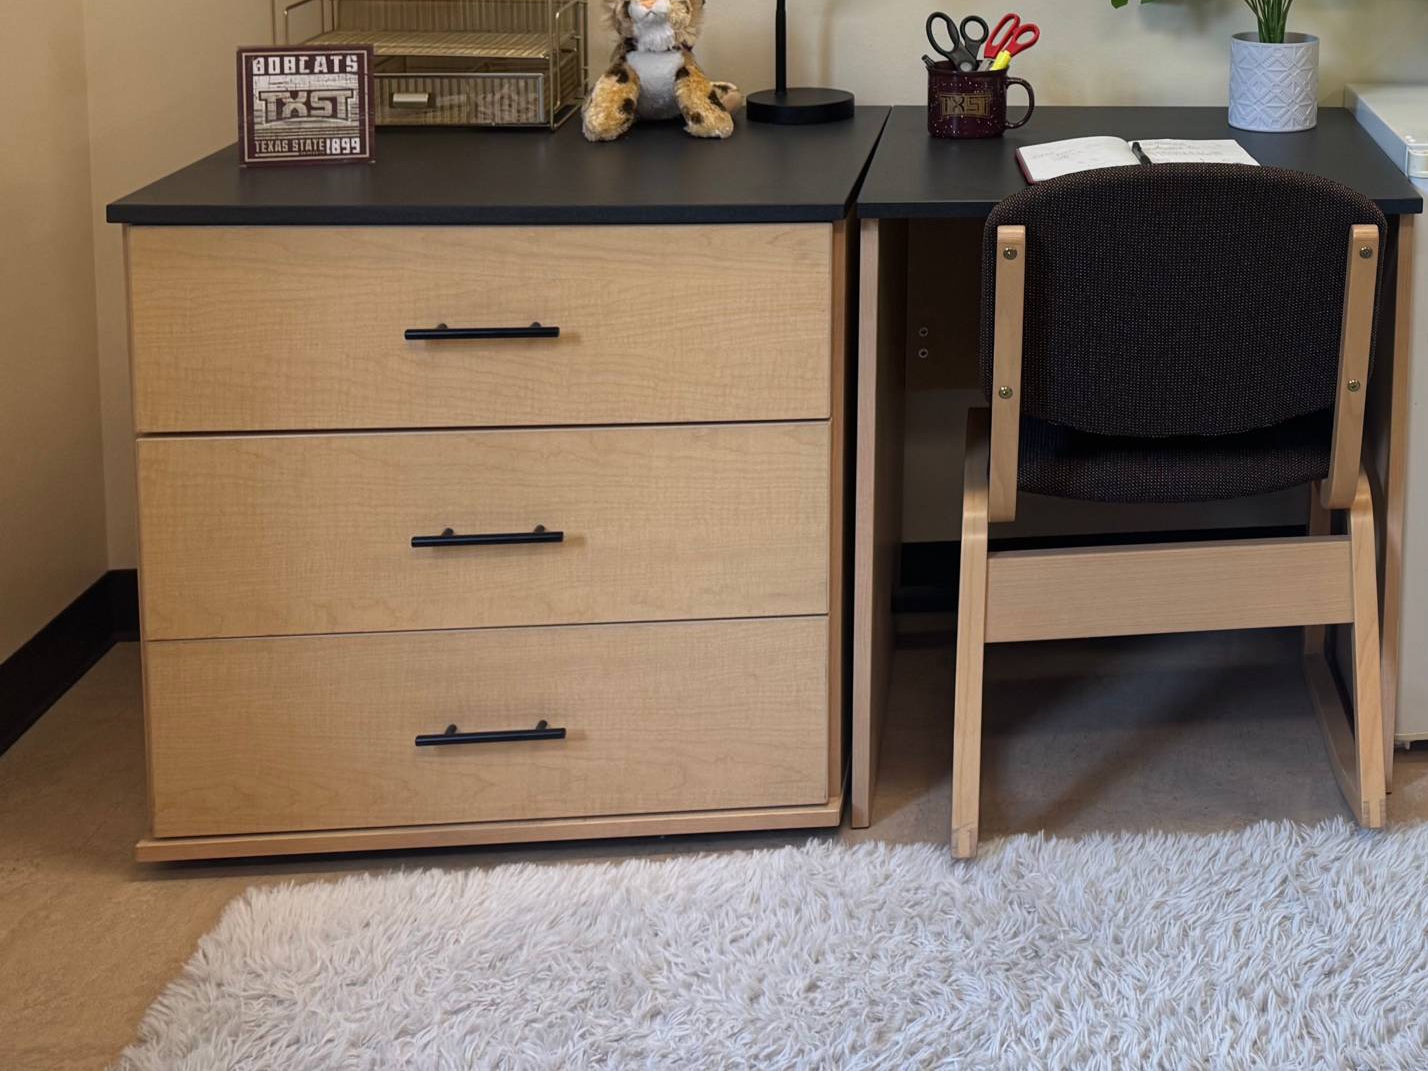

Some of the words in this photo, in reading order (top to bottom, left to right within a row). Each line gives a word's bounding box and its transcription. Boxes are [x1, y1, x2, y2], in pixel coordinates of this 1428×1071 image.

[252, 55, 358, 75] BOBCATS
[259, 89, 354, 124] TXST
[255, 139, 289, 153] TEXAS
[292, 138, 325, 152] STATE
[325, 137, 360, 155] 1899
